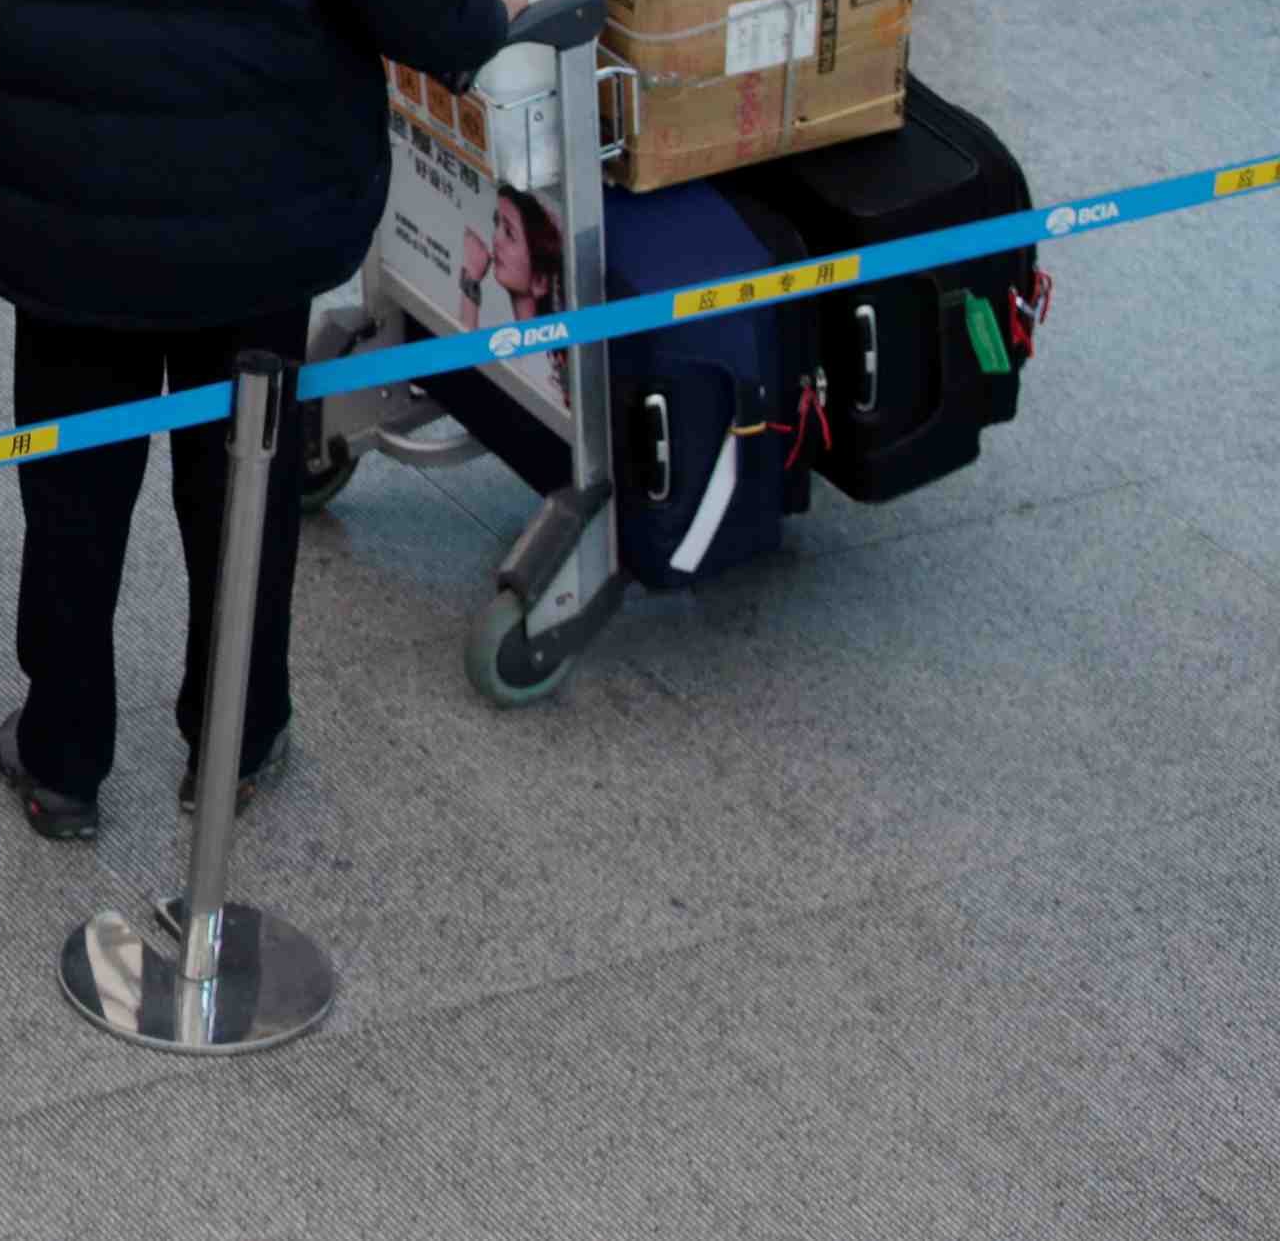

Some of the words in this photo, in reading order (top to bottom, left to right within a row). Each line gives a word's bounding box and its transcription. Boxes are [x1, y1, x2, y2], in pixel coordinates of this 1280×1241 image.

[1077, 201, 1120, 225] BCIA
[697, 262, 835, 311] 应急专用
[523, 321, 569, 347] BCIA
